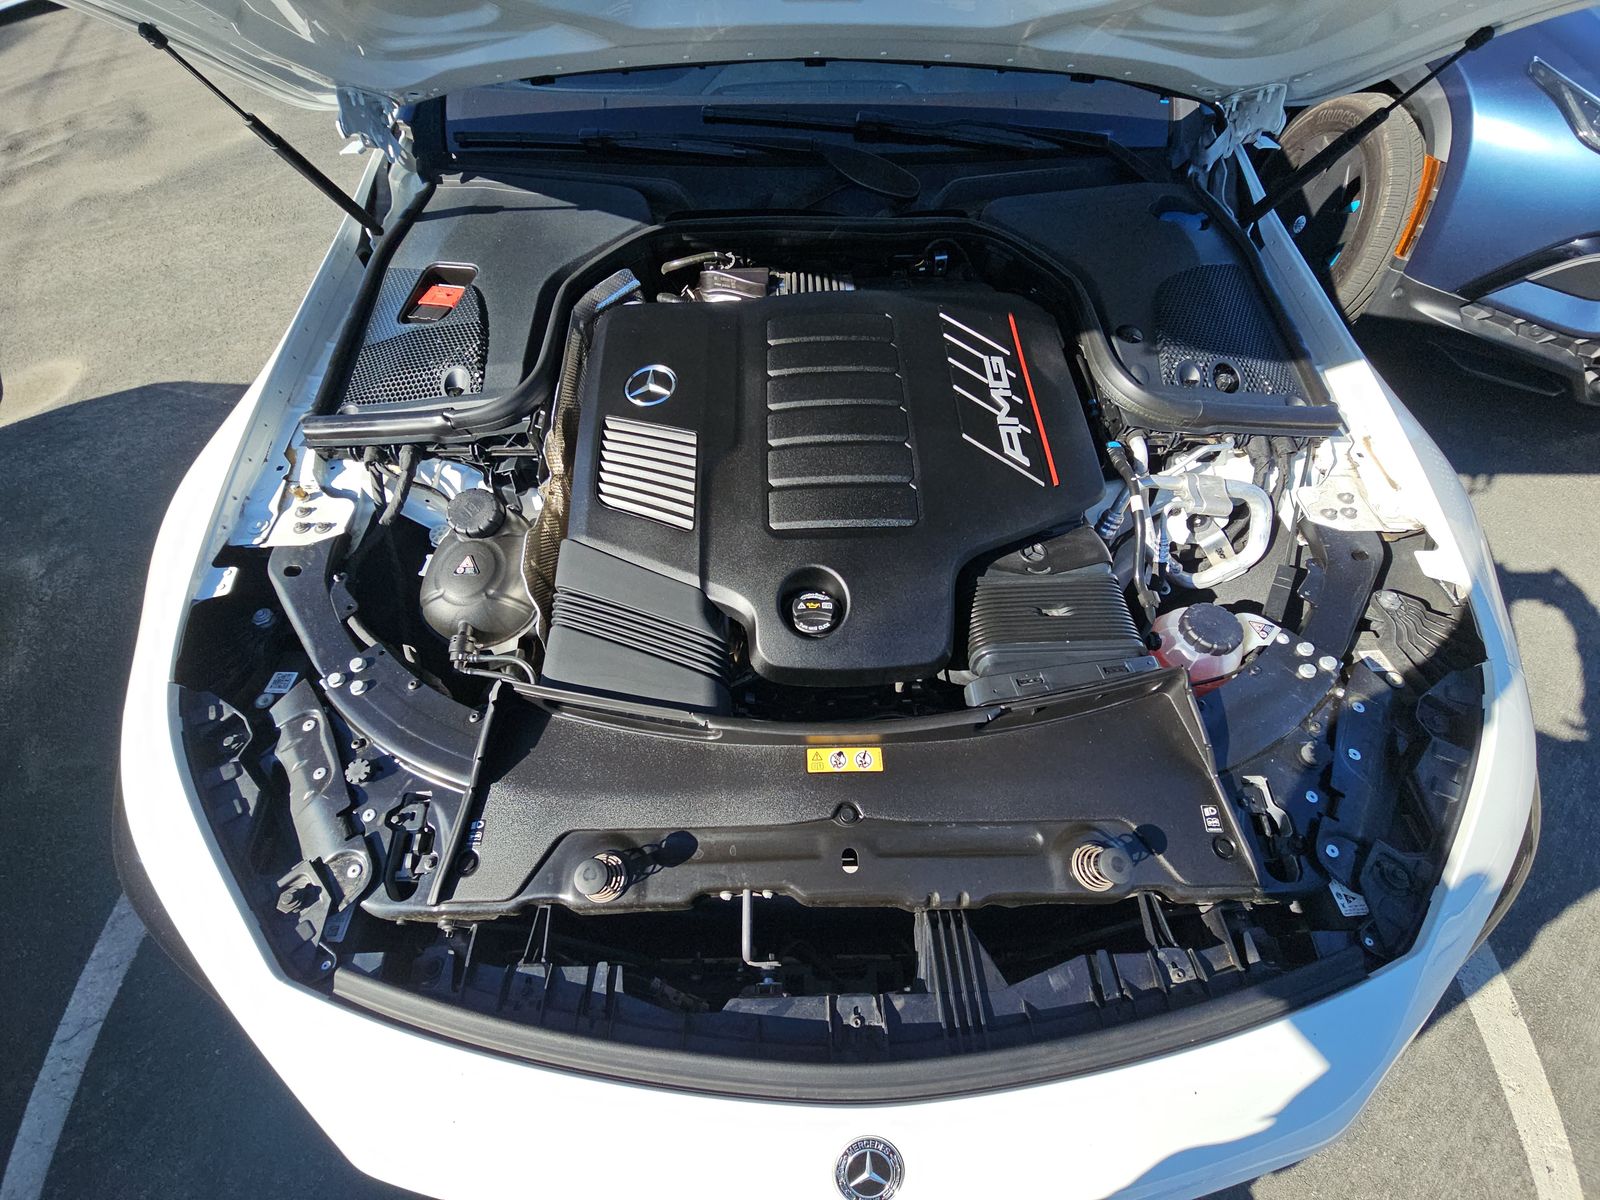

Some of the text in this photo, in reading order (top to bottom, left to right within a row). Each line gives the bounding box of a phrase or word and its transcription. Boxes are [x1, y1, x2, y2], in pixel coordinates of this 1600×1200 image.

[1318, 109, 1361, 127] BRIDGES
[983, 355, 1031, 467] AMG
[846, 1139, 892, 1157] MERCEDES
